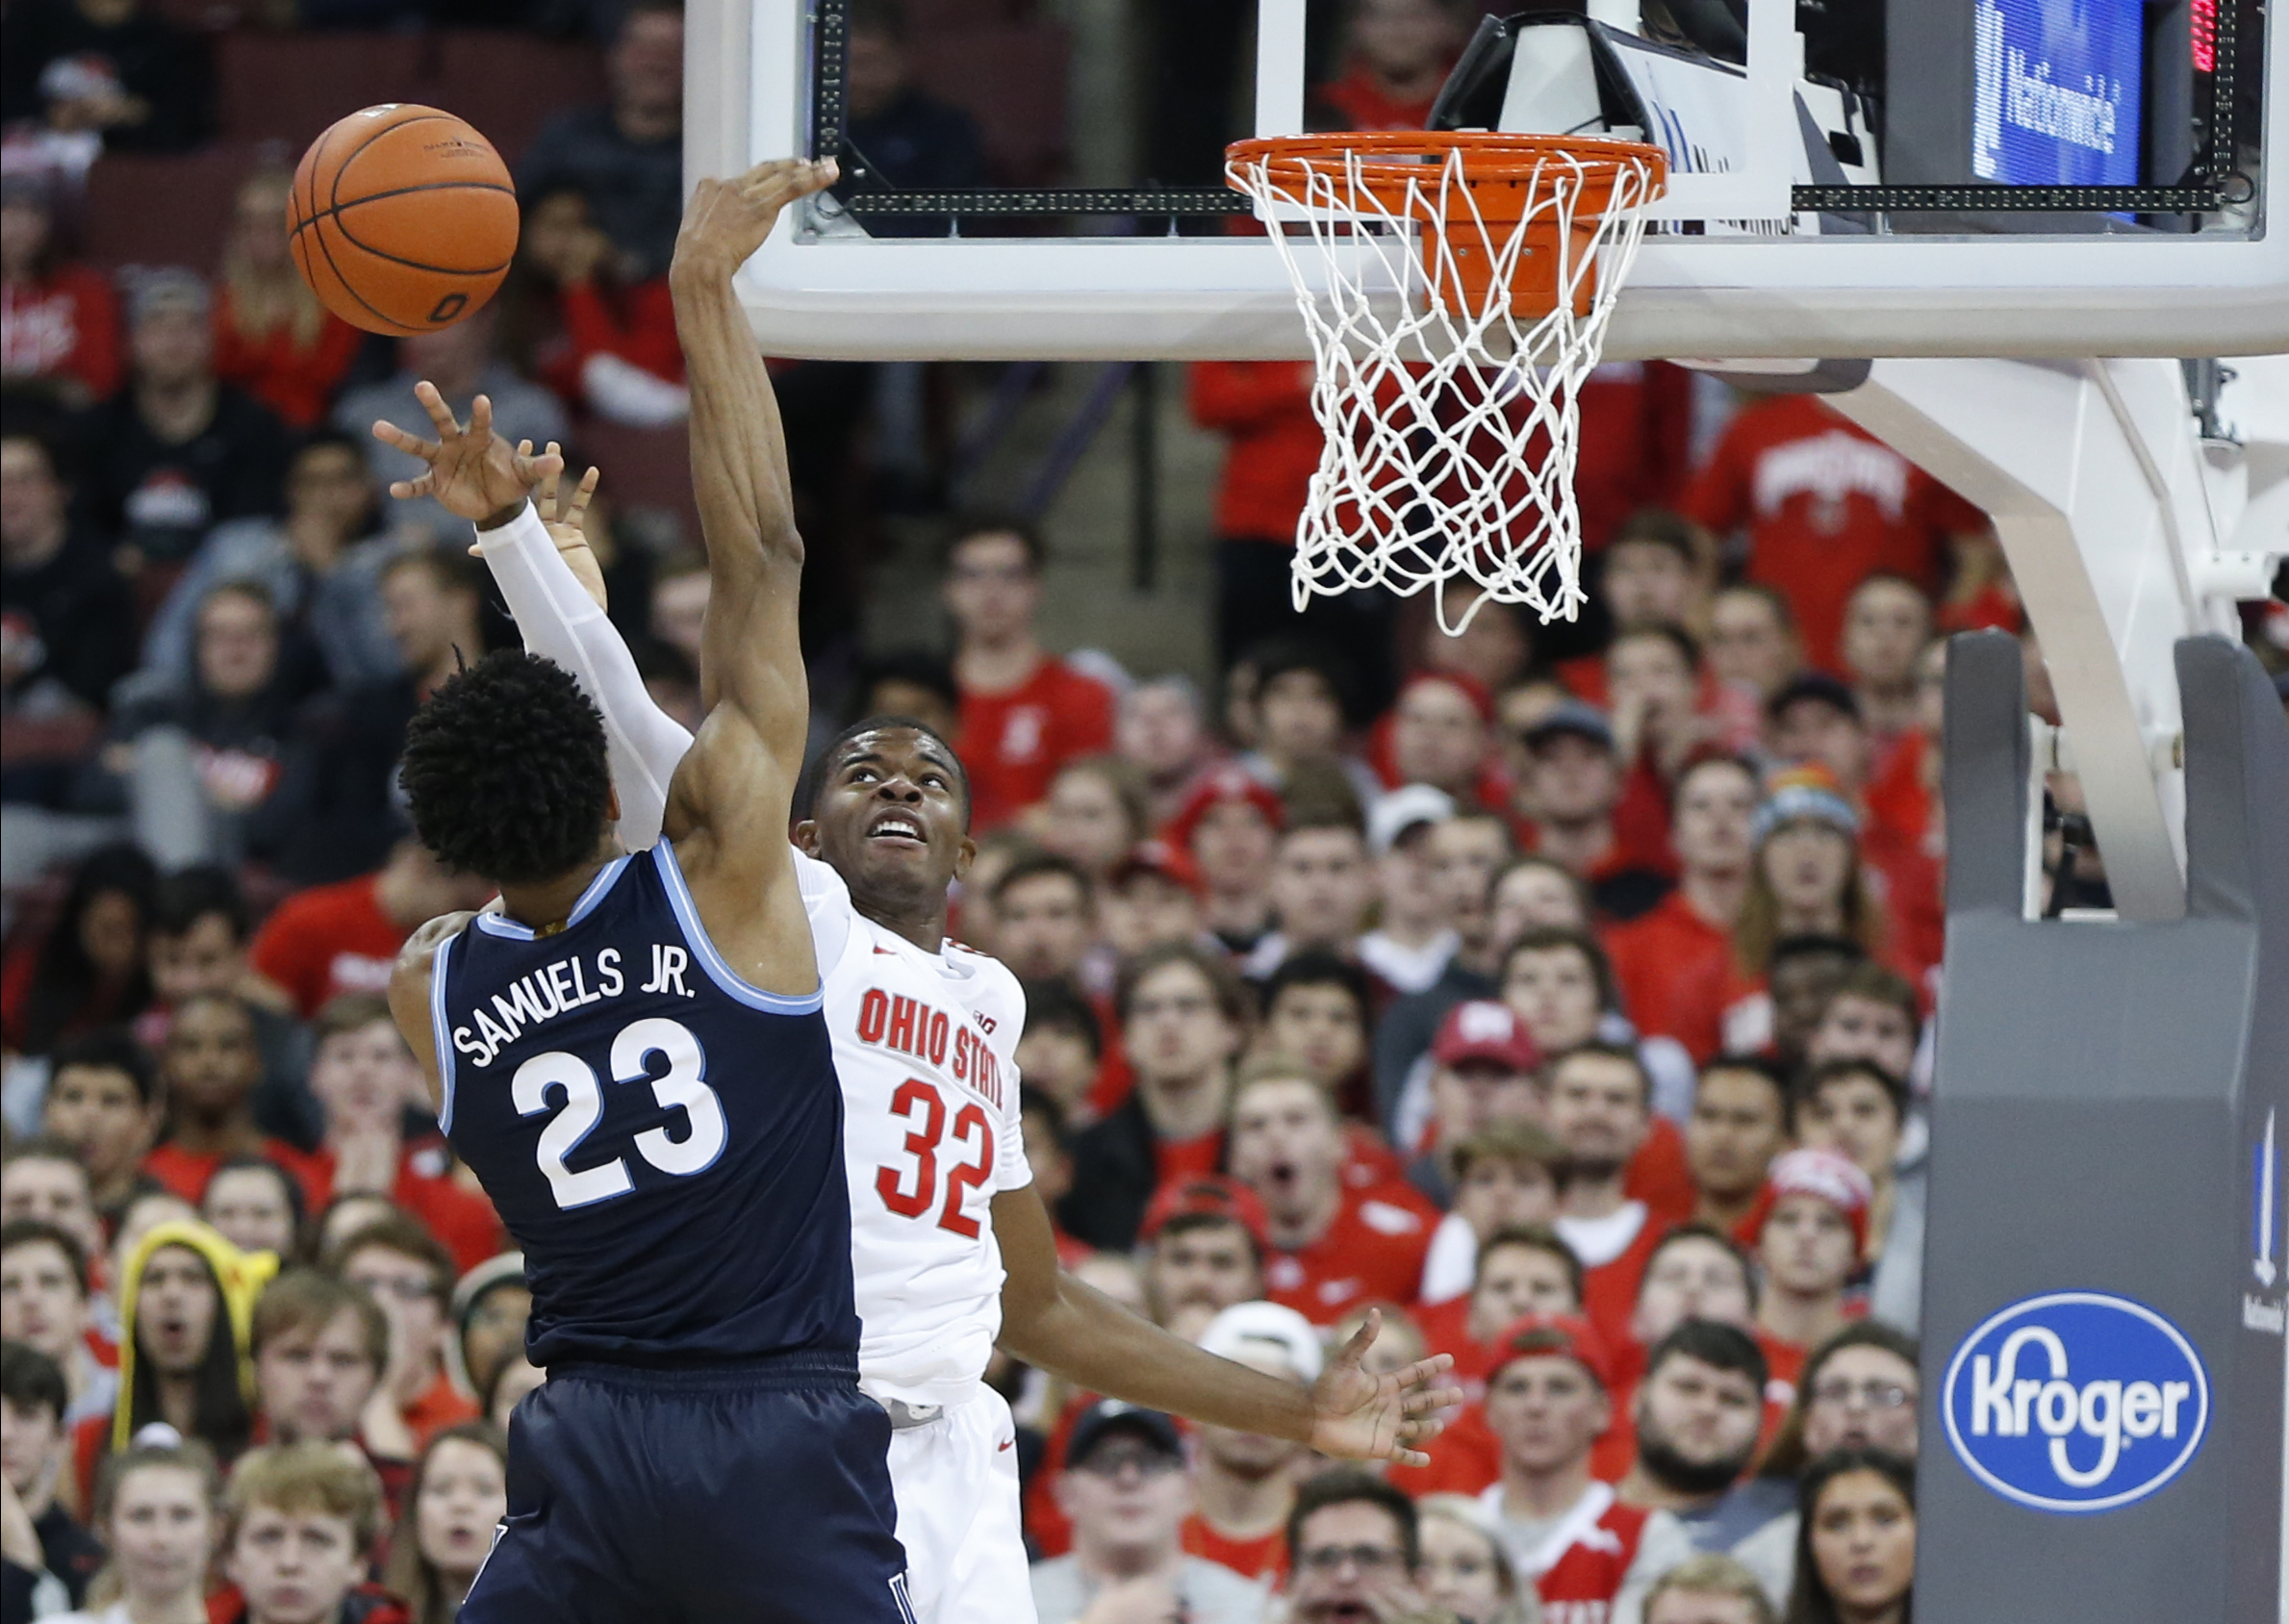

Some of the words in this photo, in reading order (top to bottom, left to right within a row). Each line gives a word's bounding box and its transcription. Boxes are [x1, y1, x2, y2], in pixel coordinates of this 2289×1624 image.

[453, 948, 624, 1068] SAMUELS
[640, 944, 696, 999] JR.
[855, 986, 949, 1069] OHIO
[511, 1017, 728, 1210] 23
[874, 1077, 995, 1241] 32
[1971, 1325, 2191, 1488] Kroger
